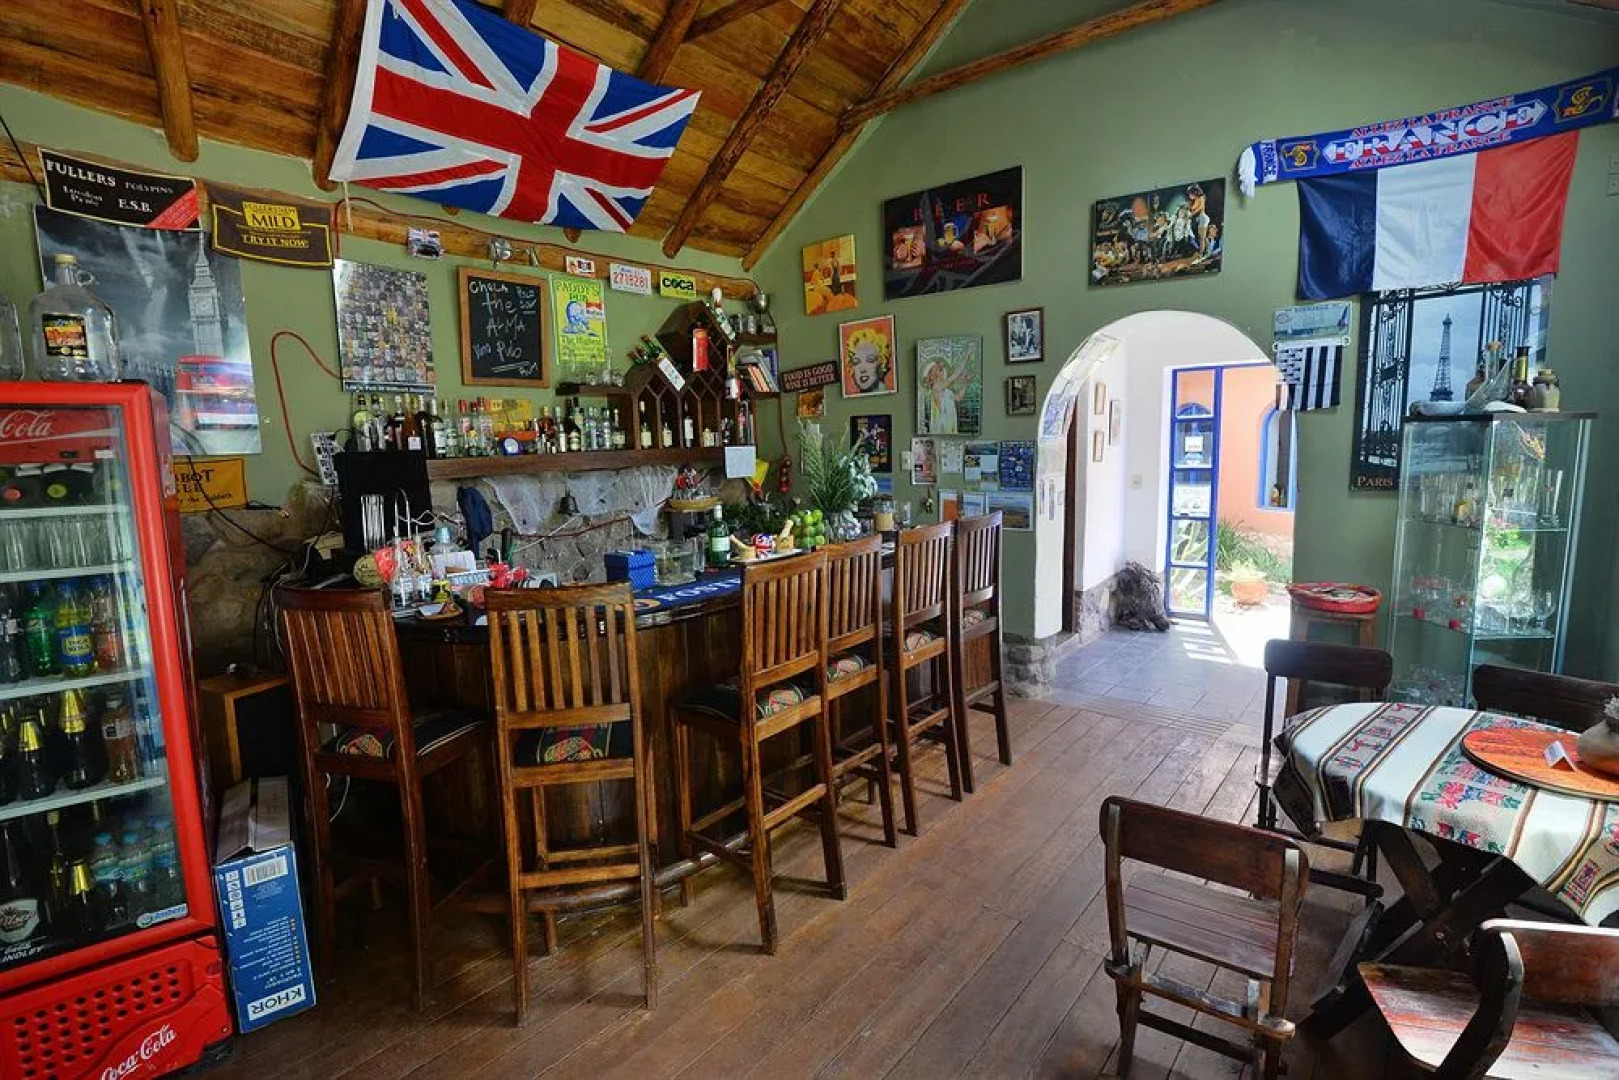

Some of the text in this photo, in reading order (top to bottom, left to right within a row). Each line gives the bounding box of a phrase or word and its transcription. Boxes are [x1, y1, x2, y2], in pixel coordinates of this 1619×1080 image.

[1330, 101, 1541, 163] FRANCE
[46, 159, 116, 187] FULLERS
[252, 213, 296, 228] MILD
[661, 278, 694, 291] coca
[1357, 475, 1393, 487] PARIS
[251, 987, 303, 1015] KHOR
